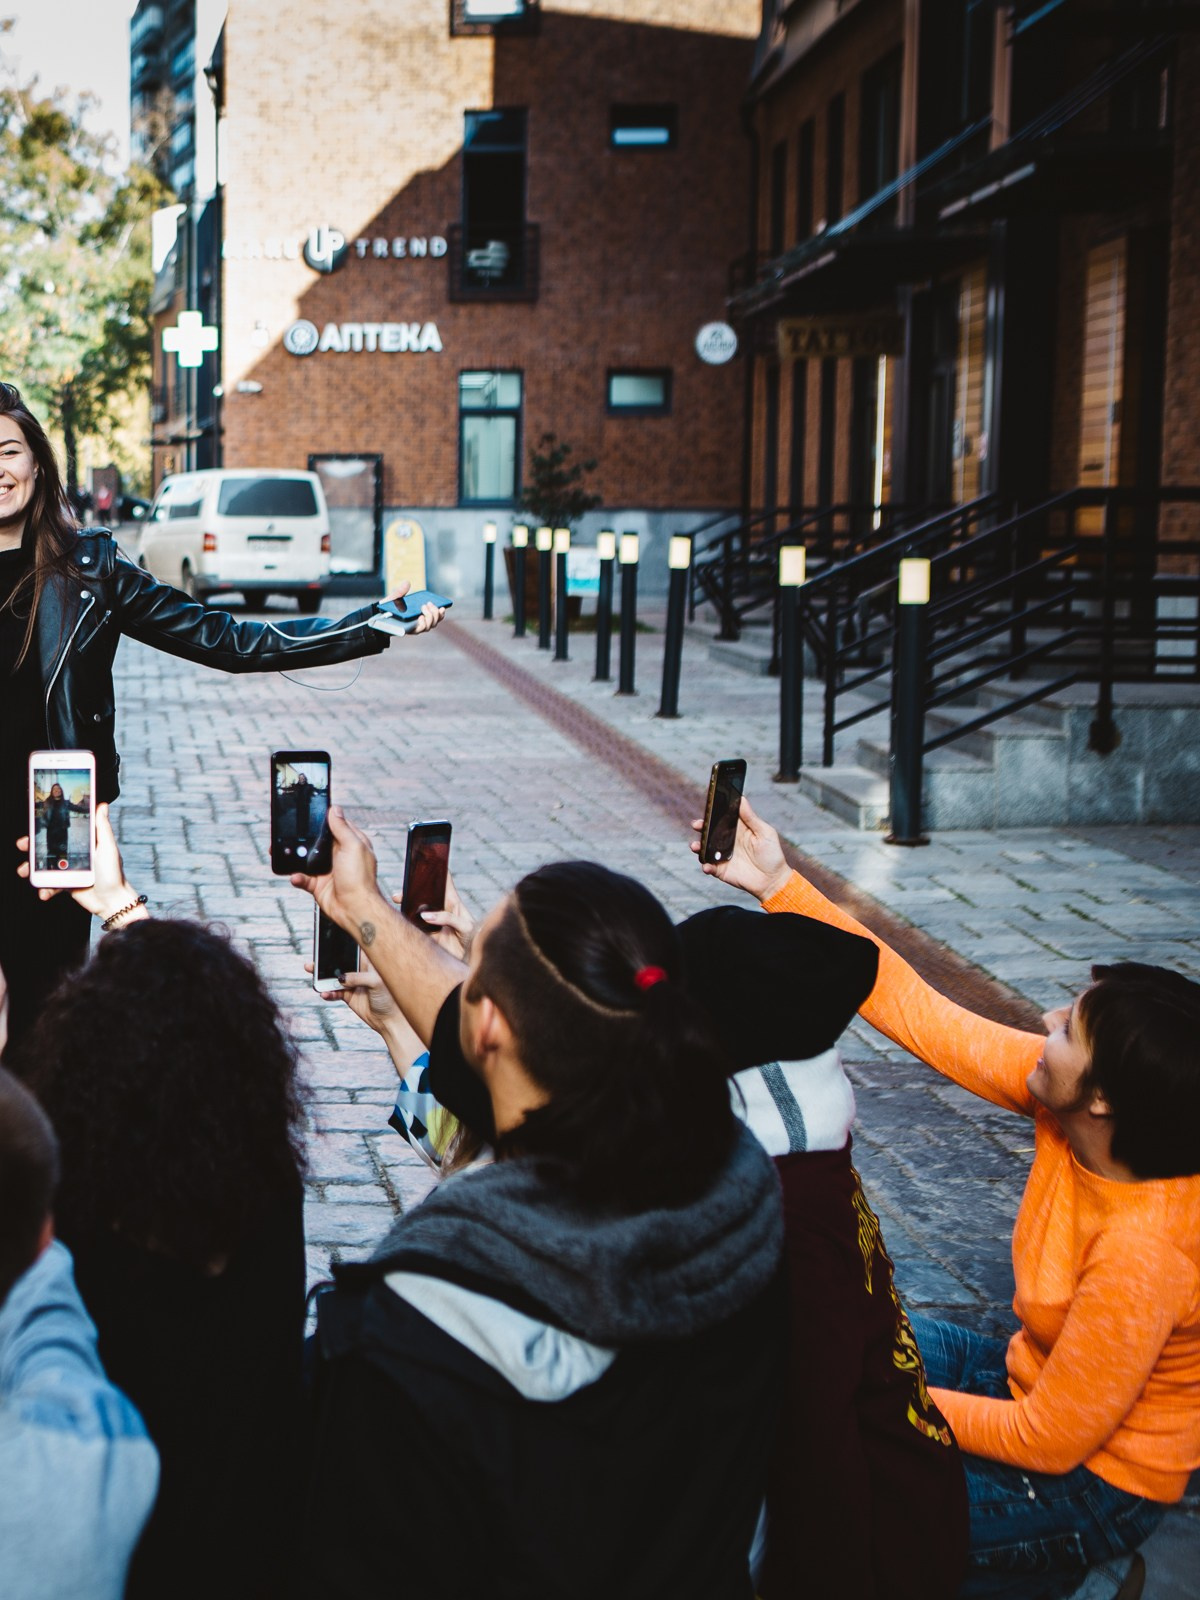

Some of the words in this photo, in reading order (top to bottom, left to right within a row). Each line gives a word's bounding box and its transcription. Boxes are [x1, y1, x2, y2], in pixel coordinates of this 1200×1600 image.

[308, 224, 345, 268] UP
[356, 236, 448, 258] TREND
[318, 322, 443, 353] АПТЕКА
